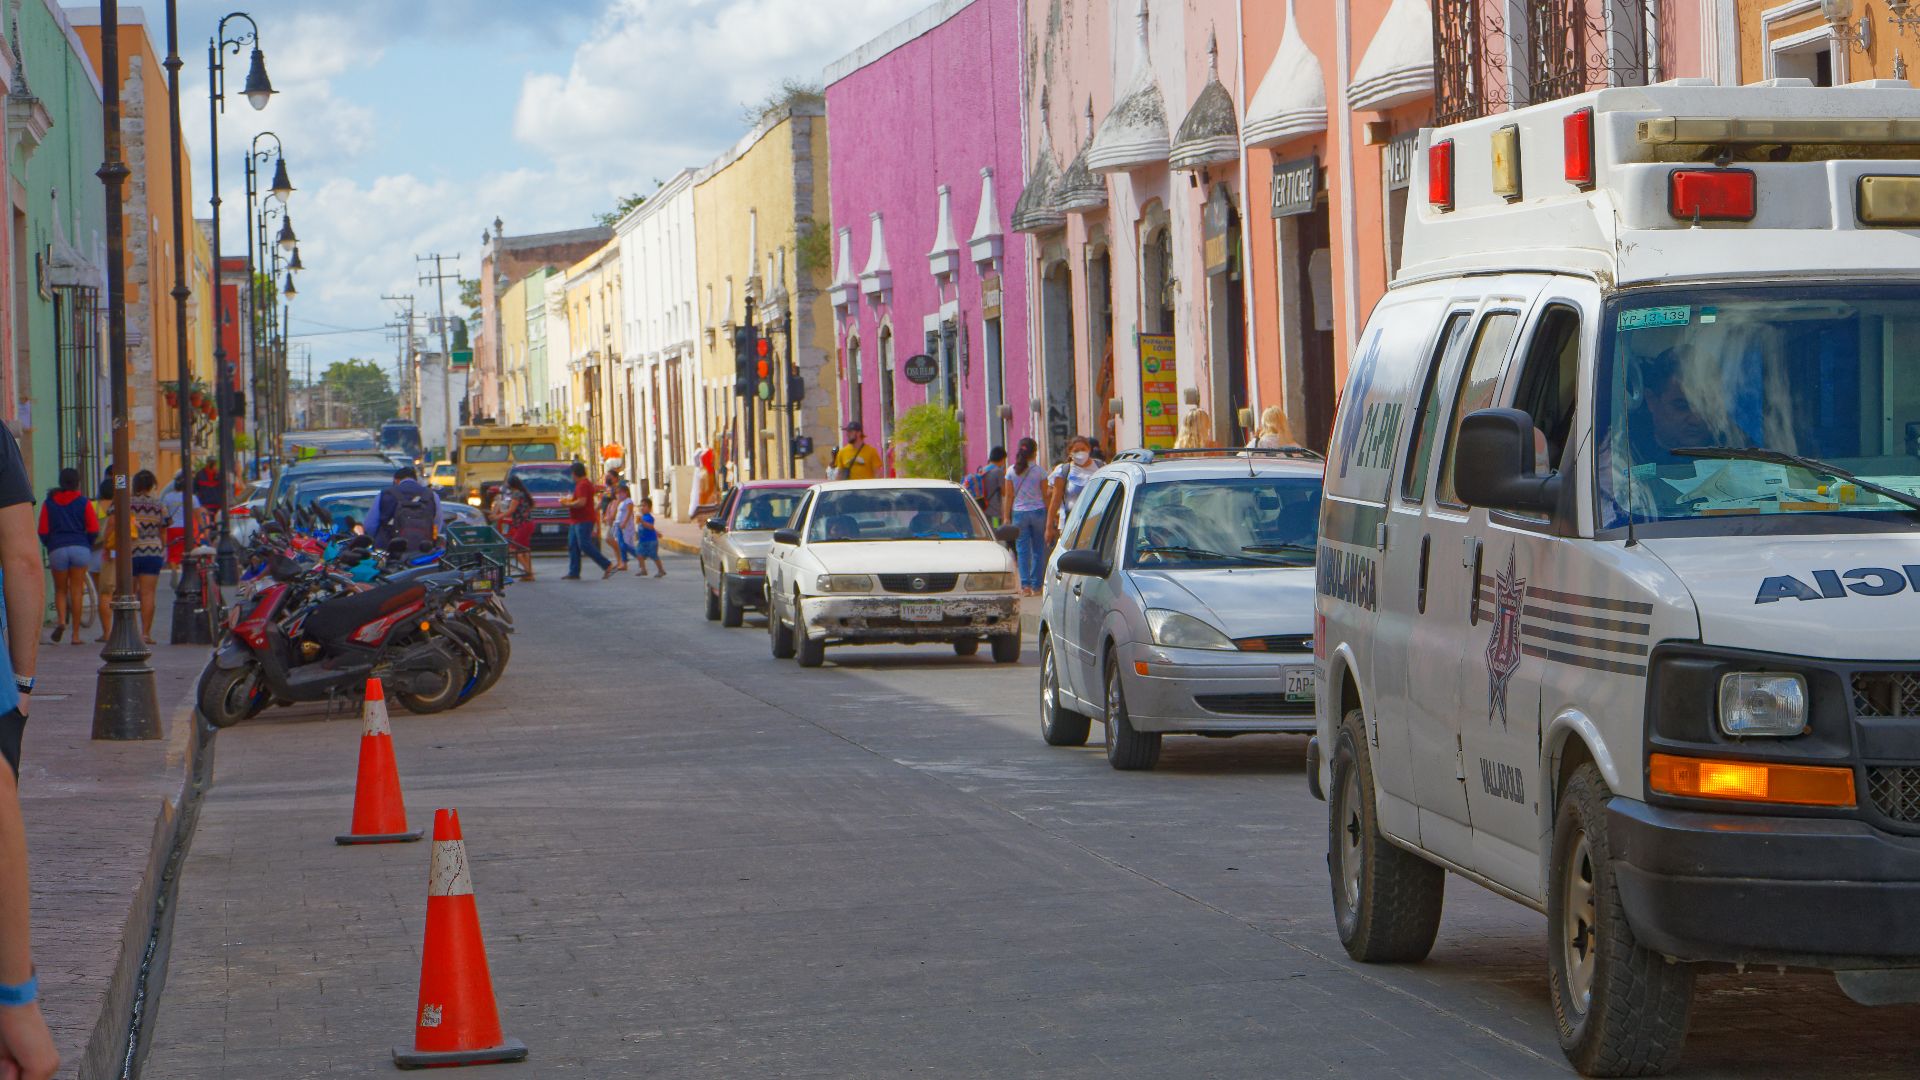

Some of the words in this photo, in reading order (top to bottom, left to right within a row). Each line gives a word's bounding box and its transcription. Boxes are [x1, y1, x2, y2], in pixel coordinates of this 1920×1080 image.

[1388, 136, 1419, 182] VERTI
[1271, 168, 1311, 207] VERTICHE
[1357, 403, 1402, 469] 21-PM
[1317, 544, 1376, 612] AMBULANCIA
[1479, 757, 1525, 804] VALLADOLID
